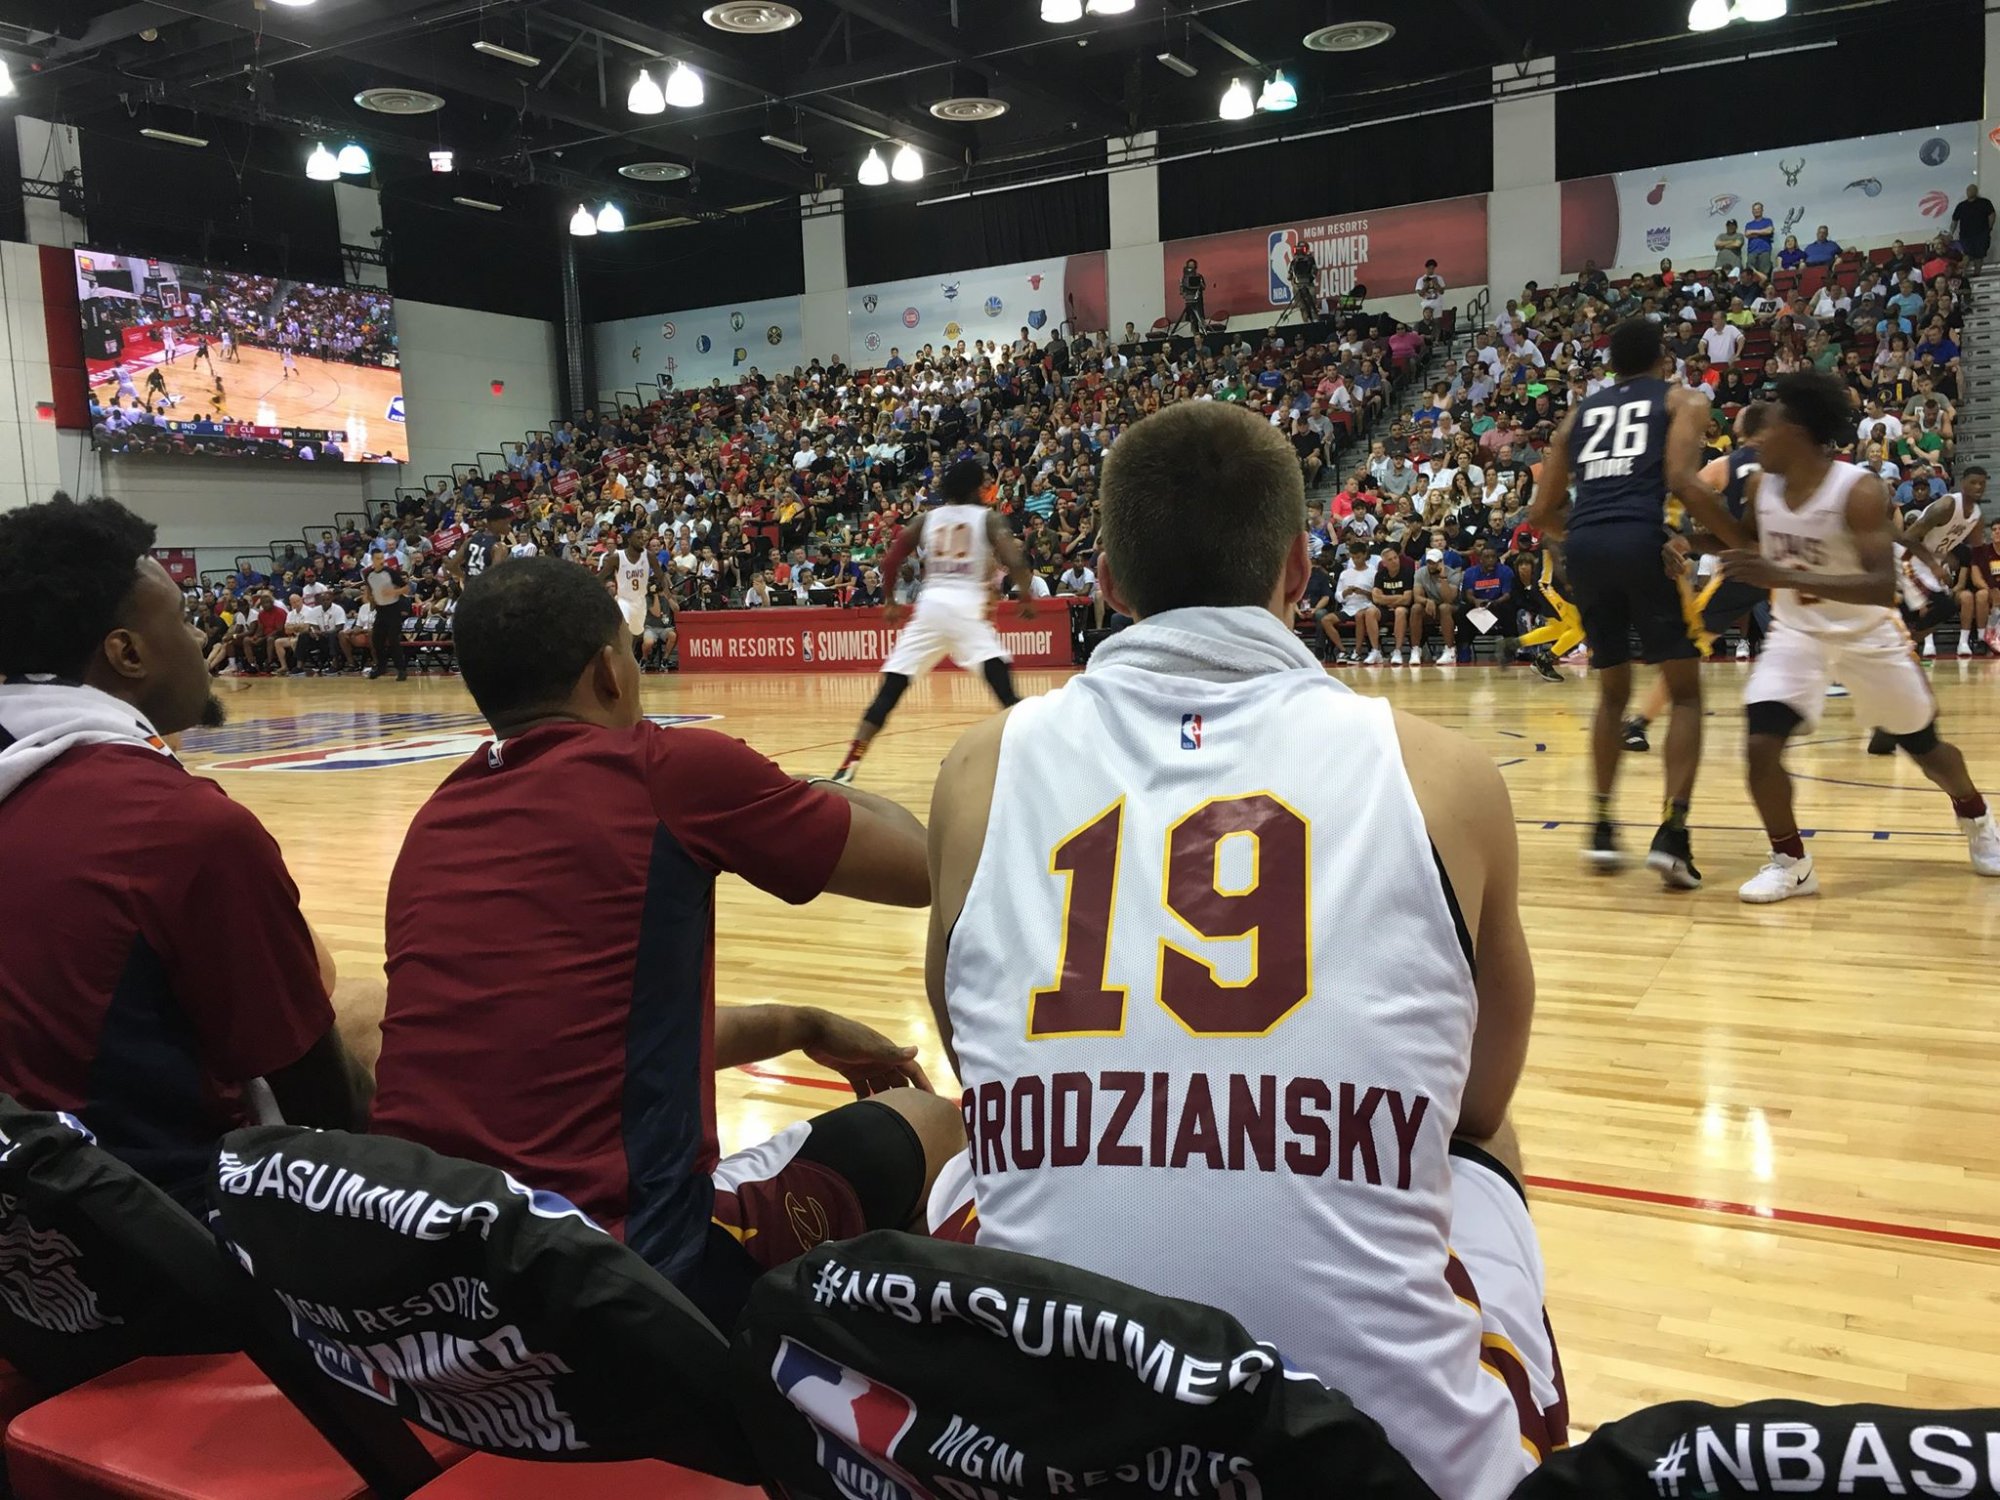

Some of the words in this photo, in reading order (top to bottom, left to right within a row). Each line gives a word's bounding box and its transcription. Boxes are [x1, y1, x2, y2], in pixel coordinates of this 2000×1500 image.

[1303, 225, 1325, 239] MGM
[1327, 219, 1369, 235] RESORTS
[1272, 287, 1288, 300] NBA
[181, 422, 197, 431] IND
[240, 426, 255, 434] CLE
[1577, 399, 1652, 464] 26
[625, 569, 644, 580] CAVS
[632, 578, 639, 591] 9
[689, 638, 723, 657] MGM
[728, 637, 795, 657] RESORTS
[818, 630, 878, 661] SUMMER
[1025, 789, 1313, 1041] 19
[353, 1276, 499, 1334] RESORTS
[927, 1413, 1026, 1488] MGM
[1648, 1421, 2000, 1497] #NBAS
